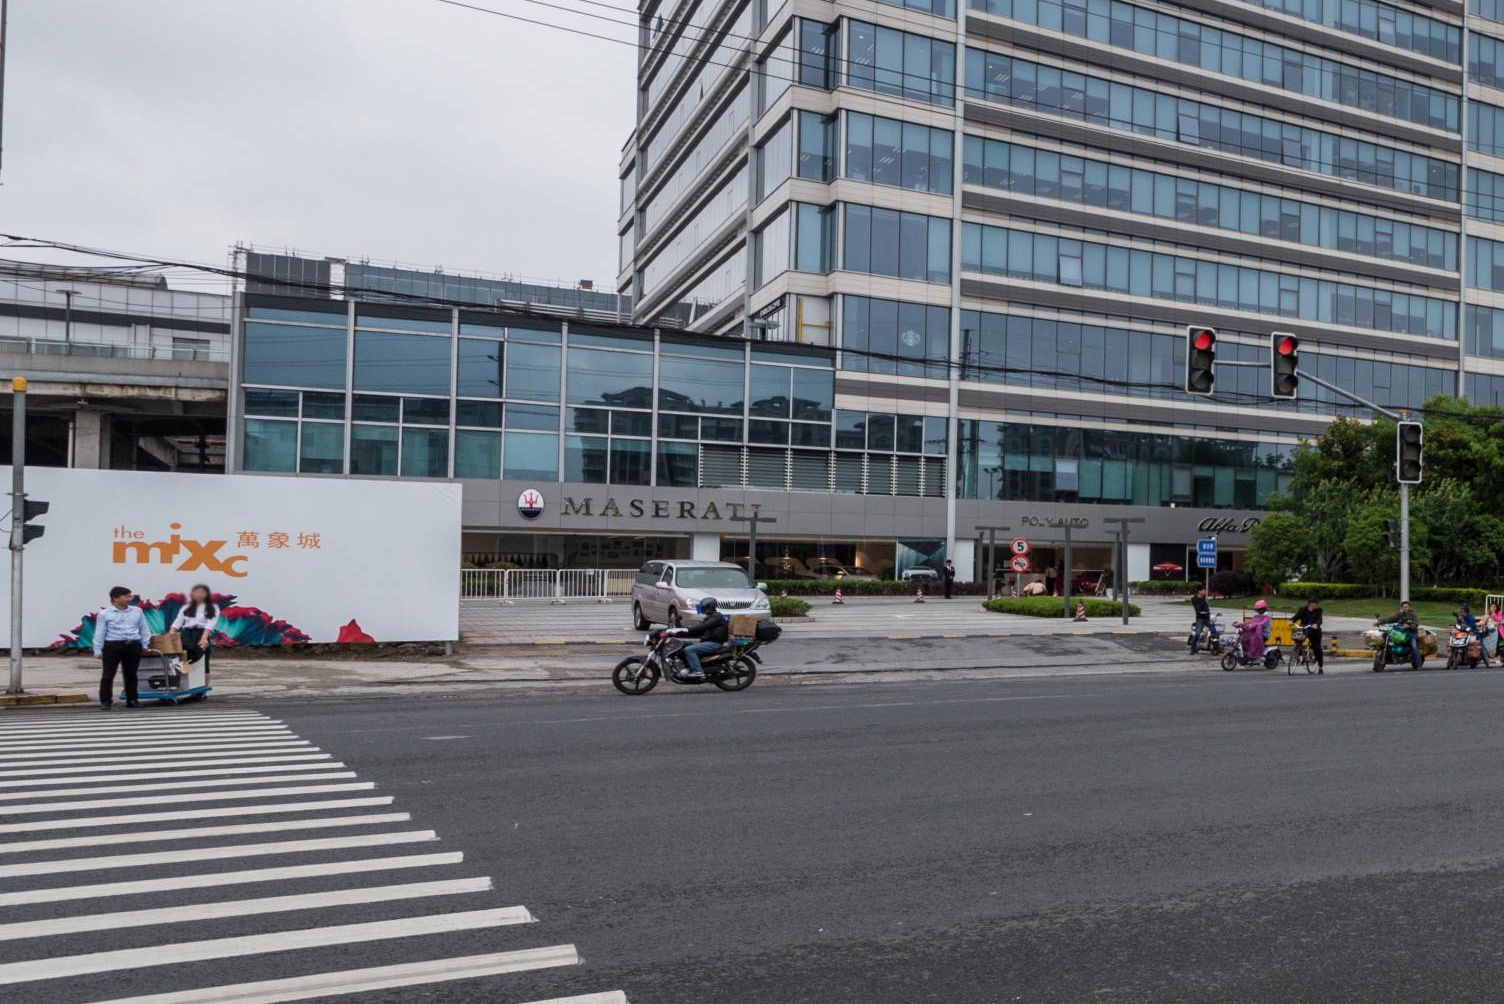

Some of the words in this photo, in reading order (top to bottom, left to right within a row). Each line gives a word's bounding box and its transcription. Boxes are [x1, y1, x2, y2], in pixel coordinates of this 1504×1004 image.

[561, 497, 762, 520] MASERATI
[1021, 516, 1056, 527] POLY
[1057, 517, 1089, 529] AUTO
[1198, 517, 1237, 534] Alfa
[113, 526, 144, 539] the
[236, 531, 321, 549] 萬象城
[112, 522, 248, 577] mixc
[1017, 542, 1024, 552] 5
